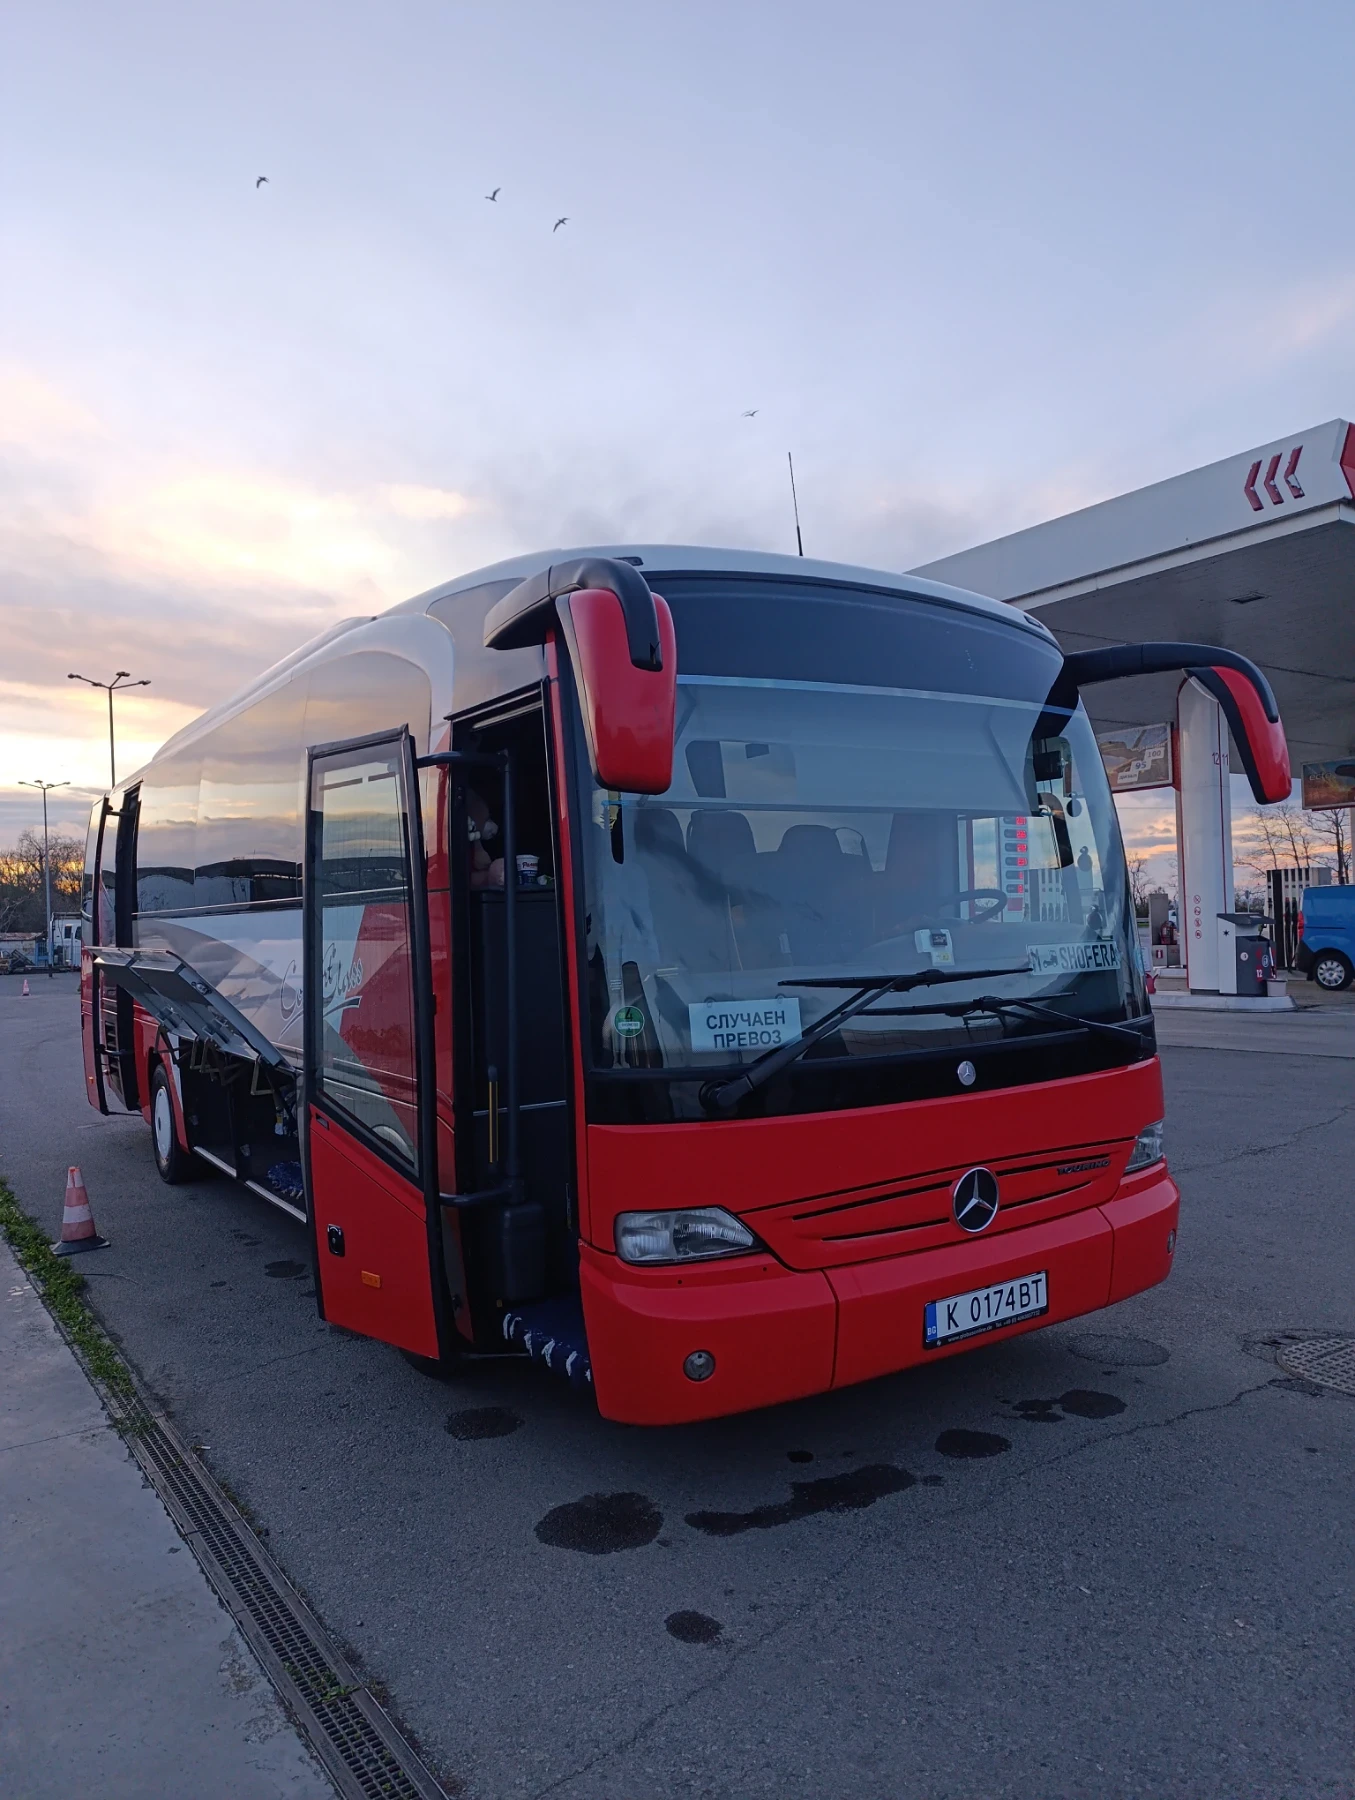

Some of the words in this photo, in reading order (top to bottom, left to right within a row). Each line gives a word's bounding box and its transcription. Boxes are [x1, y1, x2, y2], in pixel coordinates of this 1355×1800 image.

[1135, 761, 1147, 770] 95
[1059, 944, 1118, 970] SHOFERA
[624, 1007, 634, 1022] 4
[706, 1010, 785, 1030] СЛУЧАЕН
[713, 1030, 782, 1048] ПРЕВОЗ
[946, 1301, 959, 1330] K
[927, 1325, 937, 1336] BG
